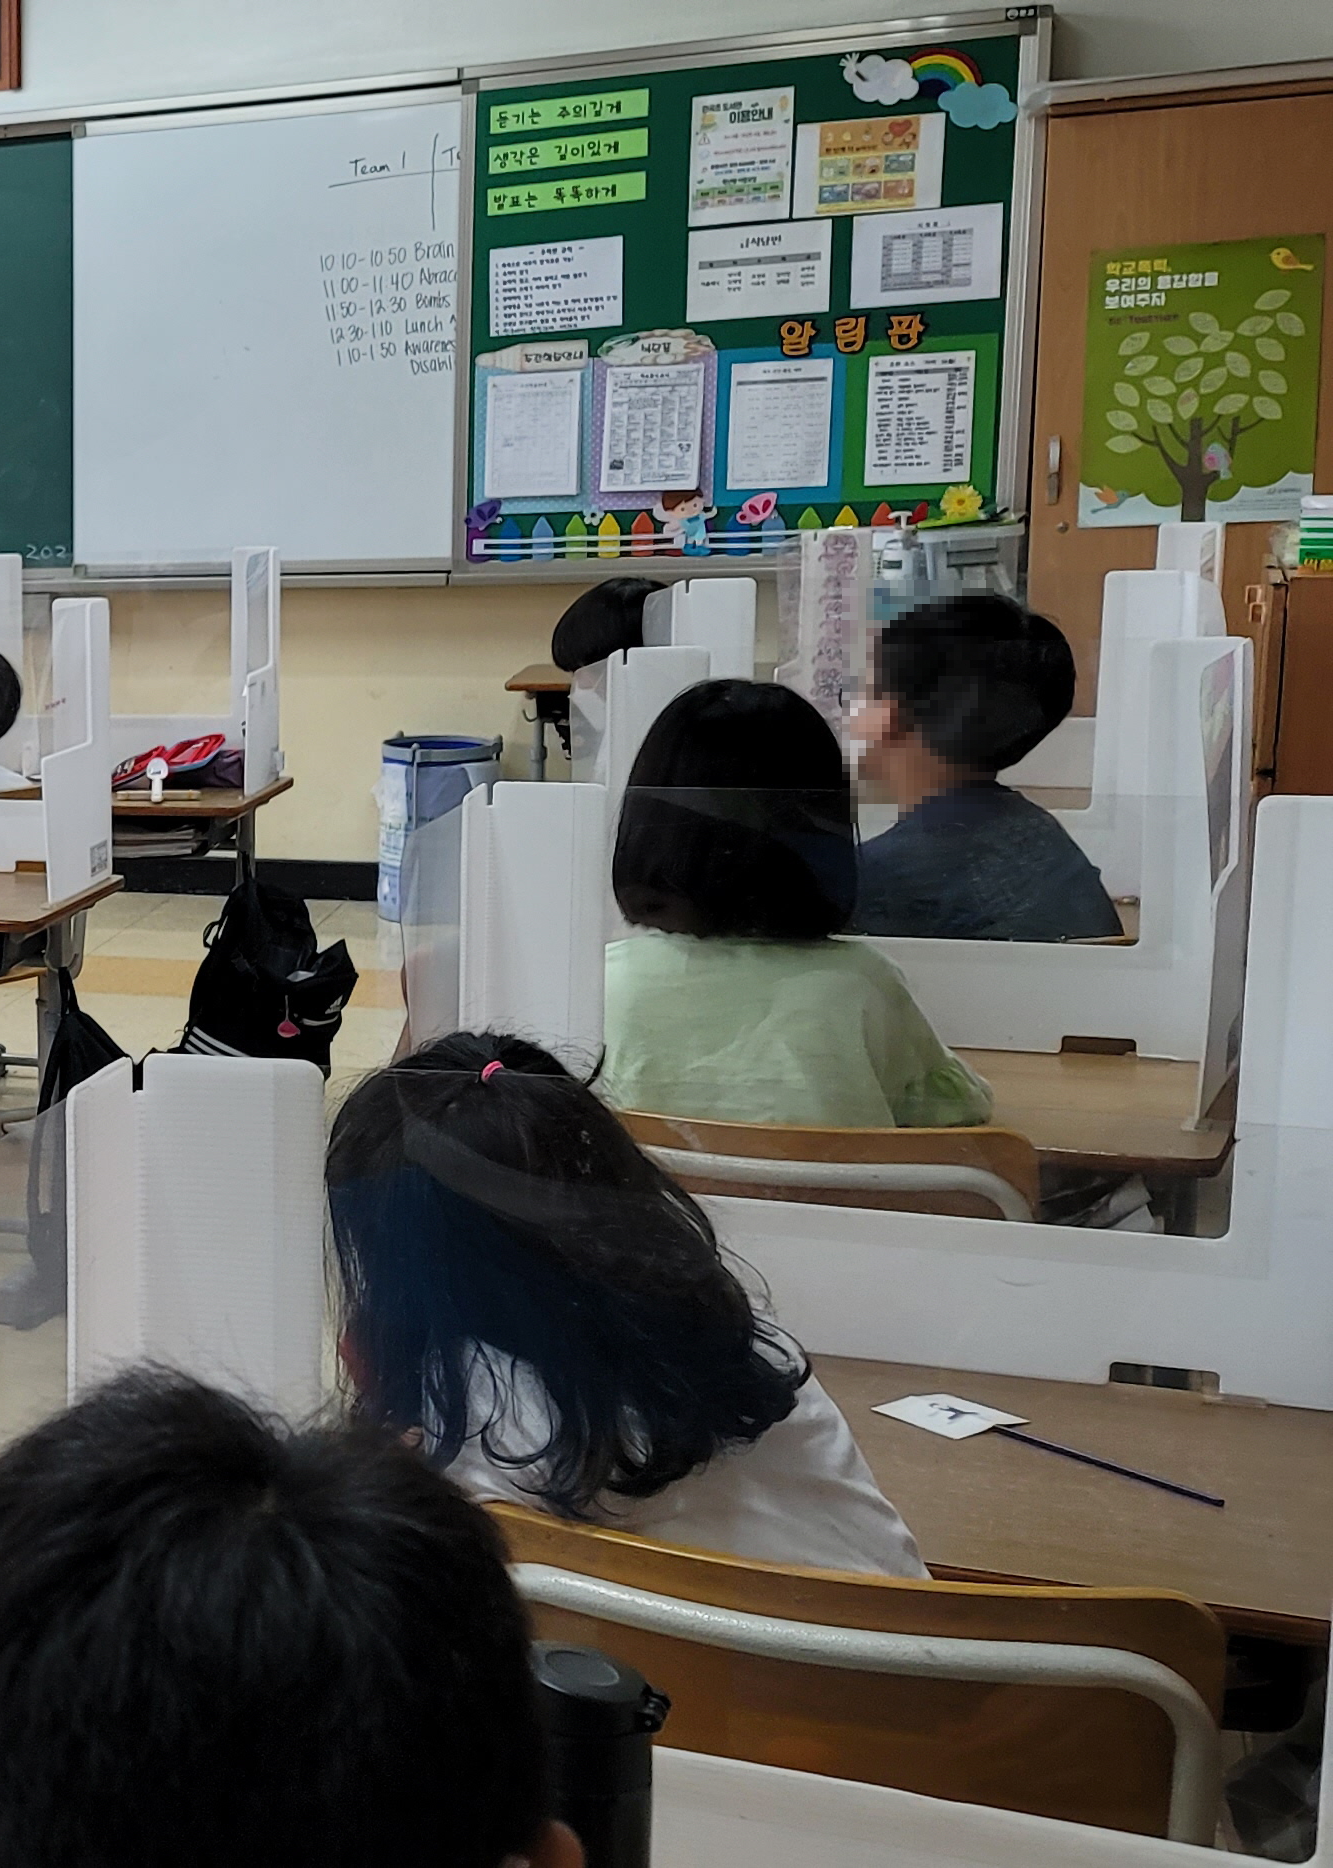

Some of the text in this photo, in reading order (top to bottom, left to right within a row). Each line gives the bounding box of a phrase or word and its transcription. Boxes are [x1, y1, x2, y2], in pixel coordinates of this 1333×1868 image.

[496, 100, 622, 128] 듣기는 주의깊게
[729, 107, 774, 124] 이용안내
[494, 140, 620, 169] 생각은 깊이있게
[349, 158, 390, 177] Team
[493, 184, 617, 211] 발표는 똑똑하게
[414, 241, 455, 262] Brain
[1105, 276, 1151, 293] 우리의
[1104, 292, 1166, 310] 보여주자
[405, 315, 443, 335] Lunch
[780, 310, 925, 356] 알림판
